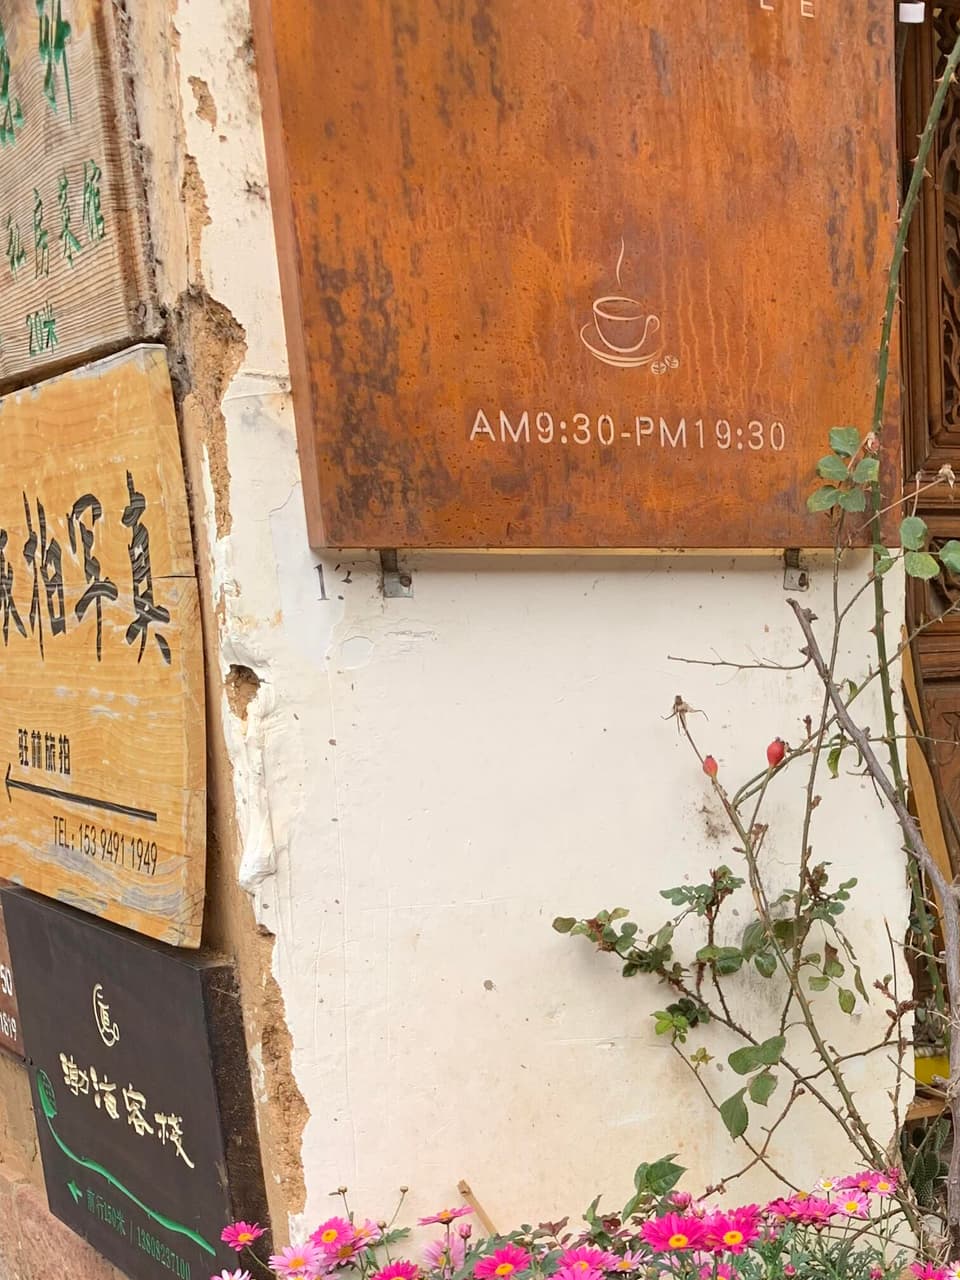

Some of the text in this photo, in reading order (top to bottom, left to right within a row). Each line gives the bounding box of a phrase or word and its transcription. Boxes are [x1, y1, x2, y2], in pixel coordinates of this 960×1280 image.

[469, 408, 787, 452] AM9:30-PM19:30
[79, 823, 97, 857] 153
[100, 828, 126, 865] 9491
[130, 837, 158, 876] 1949
